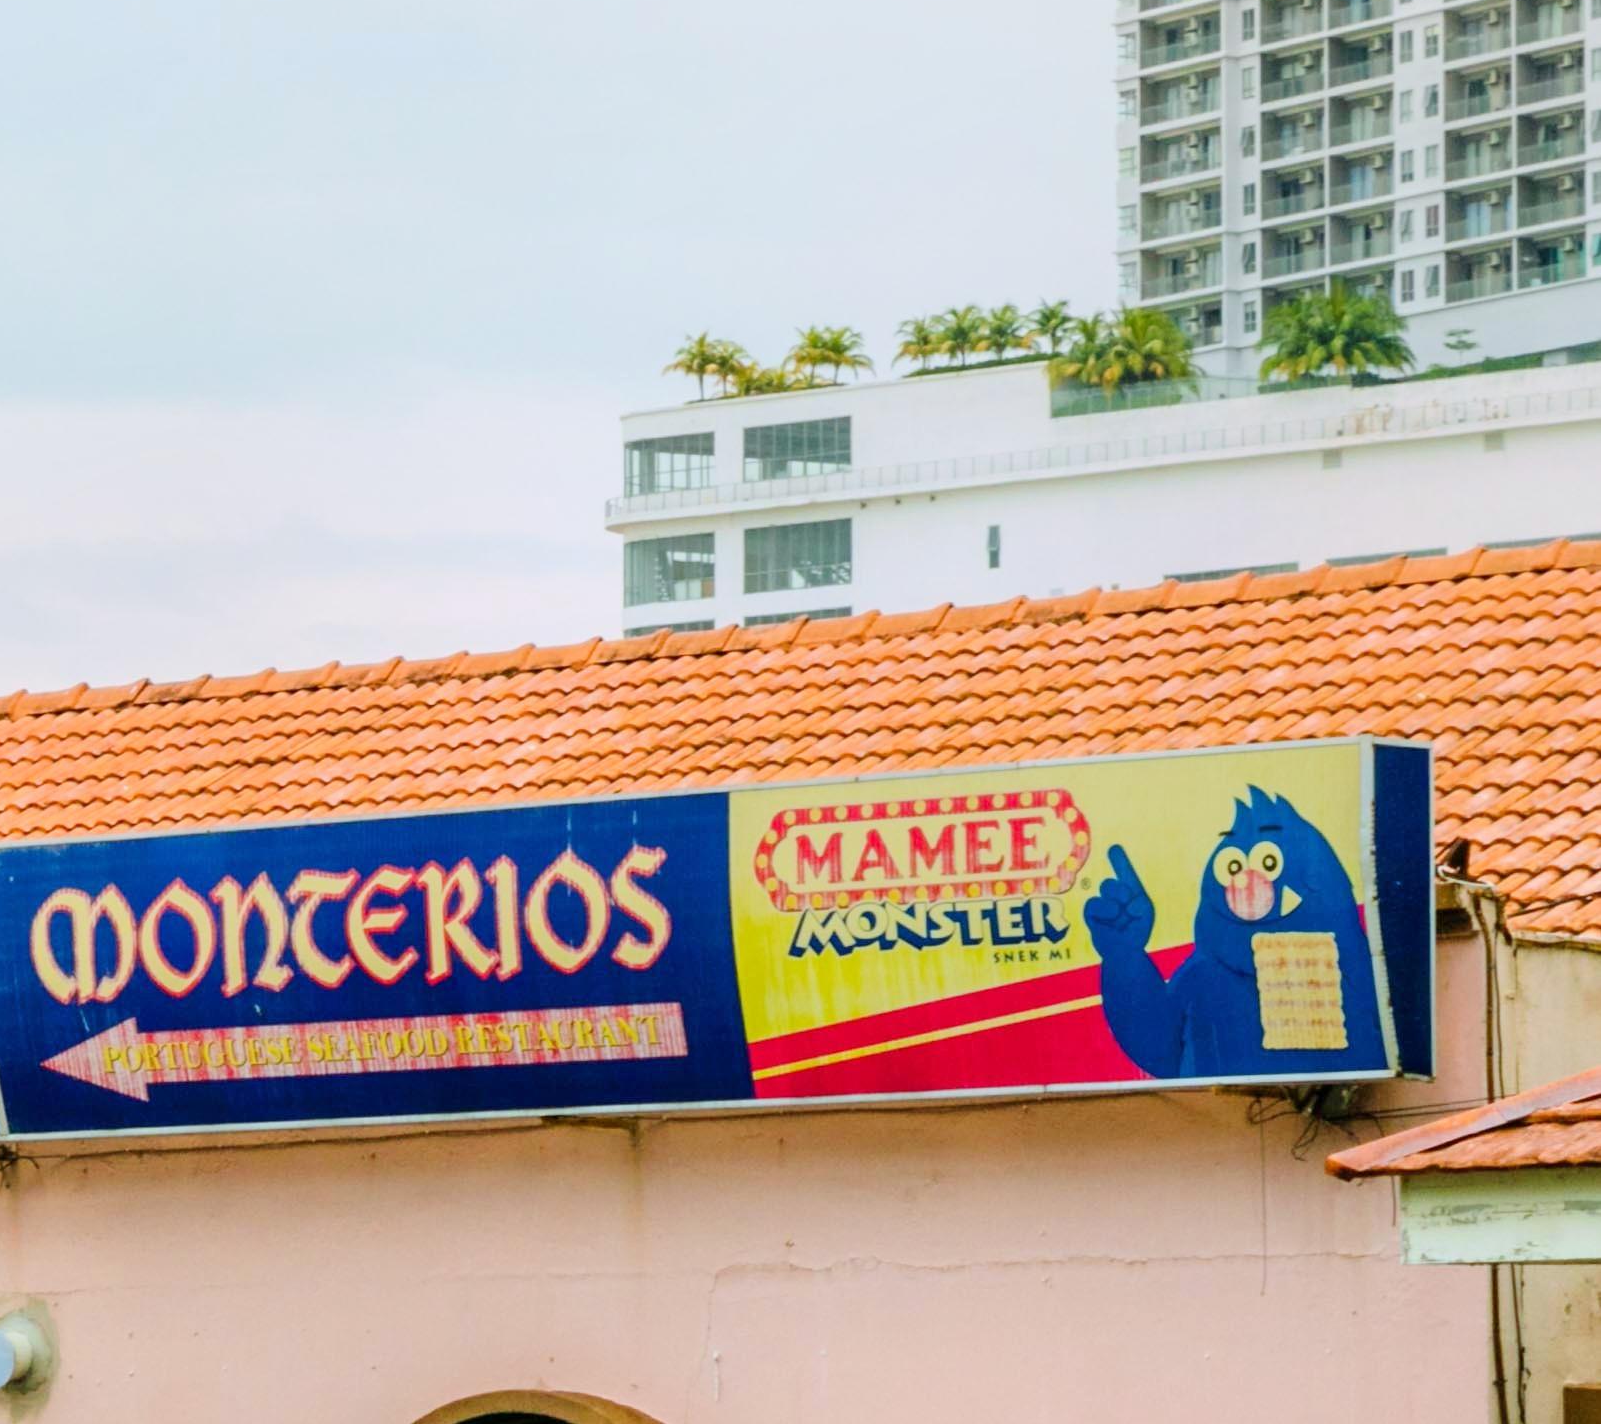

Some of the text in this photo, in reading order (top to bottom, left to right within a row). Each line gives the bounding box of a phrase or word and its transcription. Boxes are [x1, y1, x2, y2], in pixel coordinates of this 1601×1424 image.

[795, 816, 1051, 886] MAMEE
[30, 846, 671, 1005] MONTERIOS
[788, 896, 1070, 957] MONSTER
[993, 948, 1072, 964] SNEK MI
[102, 1012, 666, 1074] PORTUGUESE SEAFOOD RESTAURANT
